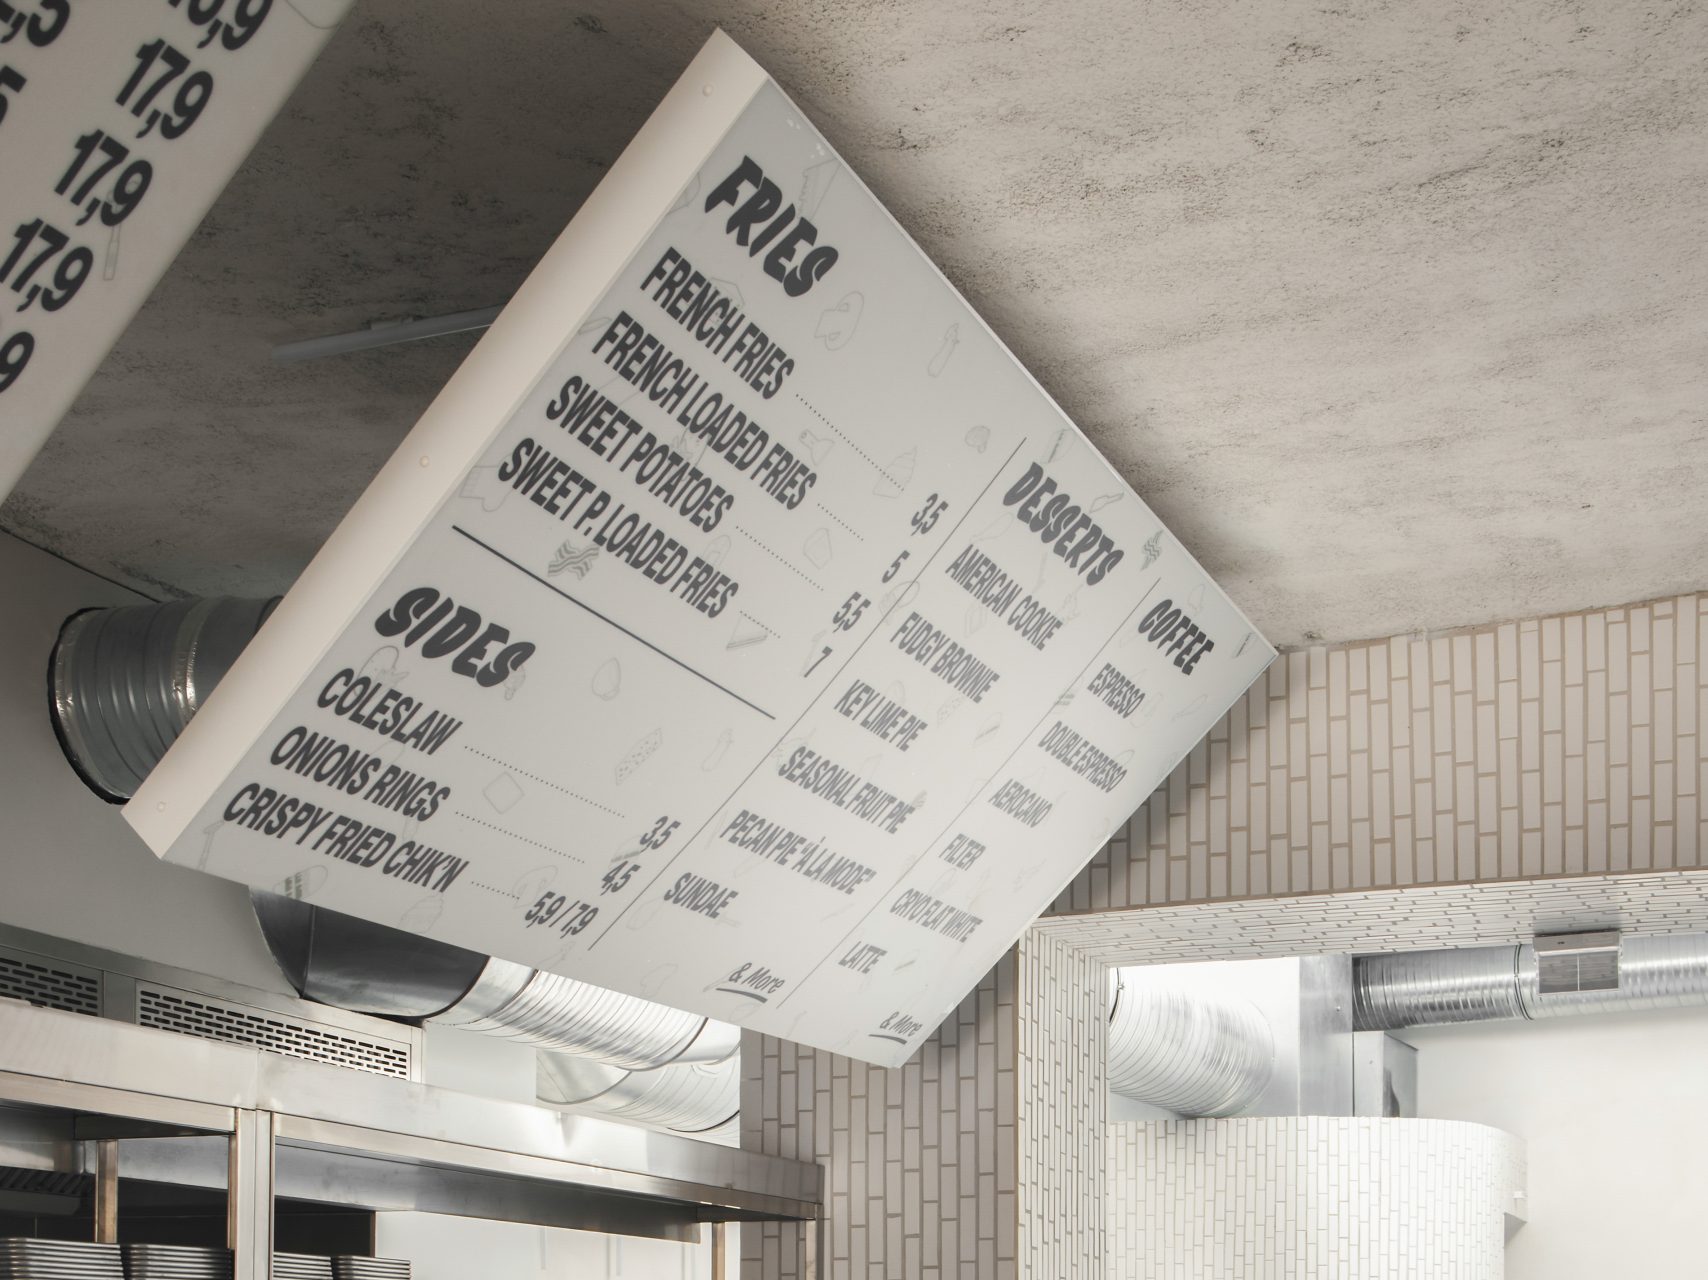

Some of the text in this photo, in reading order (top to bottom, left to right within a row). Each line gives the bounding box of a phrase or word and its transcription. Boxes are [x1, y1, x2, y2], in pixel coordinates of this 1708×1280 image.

[115, 38, 213, 139] 17,9
[54, 129, 153, 227] 17,9
[0, 218, 94, 312] 17,9
[705, 155, 839, 297] FRIES
[640, 247, 949, 536] FRENCH FRIES 3,5
[592, 311, 910, 583] FRENCH LOADED FRIES 5
[546, 376, 871, 633] SWEET POTATOES 5,5
[1003, 461, 1124, 586] DESSERTS
[498, 438, 596, 532] SWEET
[594, 504, 688, 585] LOADED
[670, 556, 739, 618] FRIES
[804, 646, 833, 678] 7
[945, 544, 1063, 651] AMERICAN COOKIE
[374, 587, 536, 687] SIDES
[890, 611, 1000, 704] FUDGY BROWNIE
[1138, 599, 1214, 676] COFFEE
[833, 679, 928, 752] KEY LIME PIE
[1087, 662, 1146, 719] ESPRESSO
[317, 668, 681, 853] COLESLAW 3,5
[778, 746, 916, 834] SEASONAL FRUIT PIE
[988, 778, 1053, 828] AEROCANO
[1038, 720, 1128, 794] DOUBLE ESPRESSO
[223, 783, 330, 846] CRISPY
[311, 814, 396, 868] FRIED
[383, 841, 469, 893] CHIK'N
[270, 726, 641, 896] ONIONS RINGS 4,5
[720, 810, 785, 859] PECAN
[774, 831, 807, 866] PIE
[939, 833, 986, 871] FILTER
[664, 872, 738, 919] SUNDAE
[916, 900, 956, 931] FLAT
[939, 909, 983, 943] WHITE
[728, 962, 785, 994] & More
[838, 941, 888, 974] LATTE
[889, 1014, 923, 1037] More
